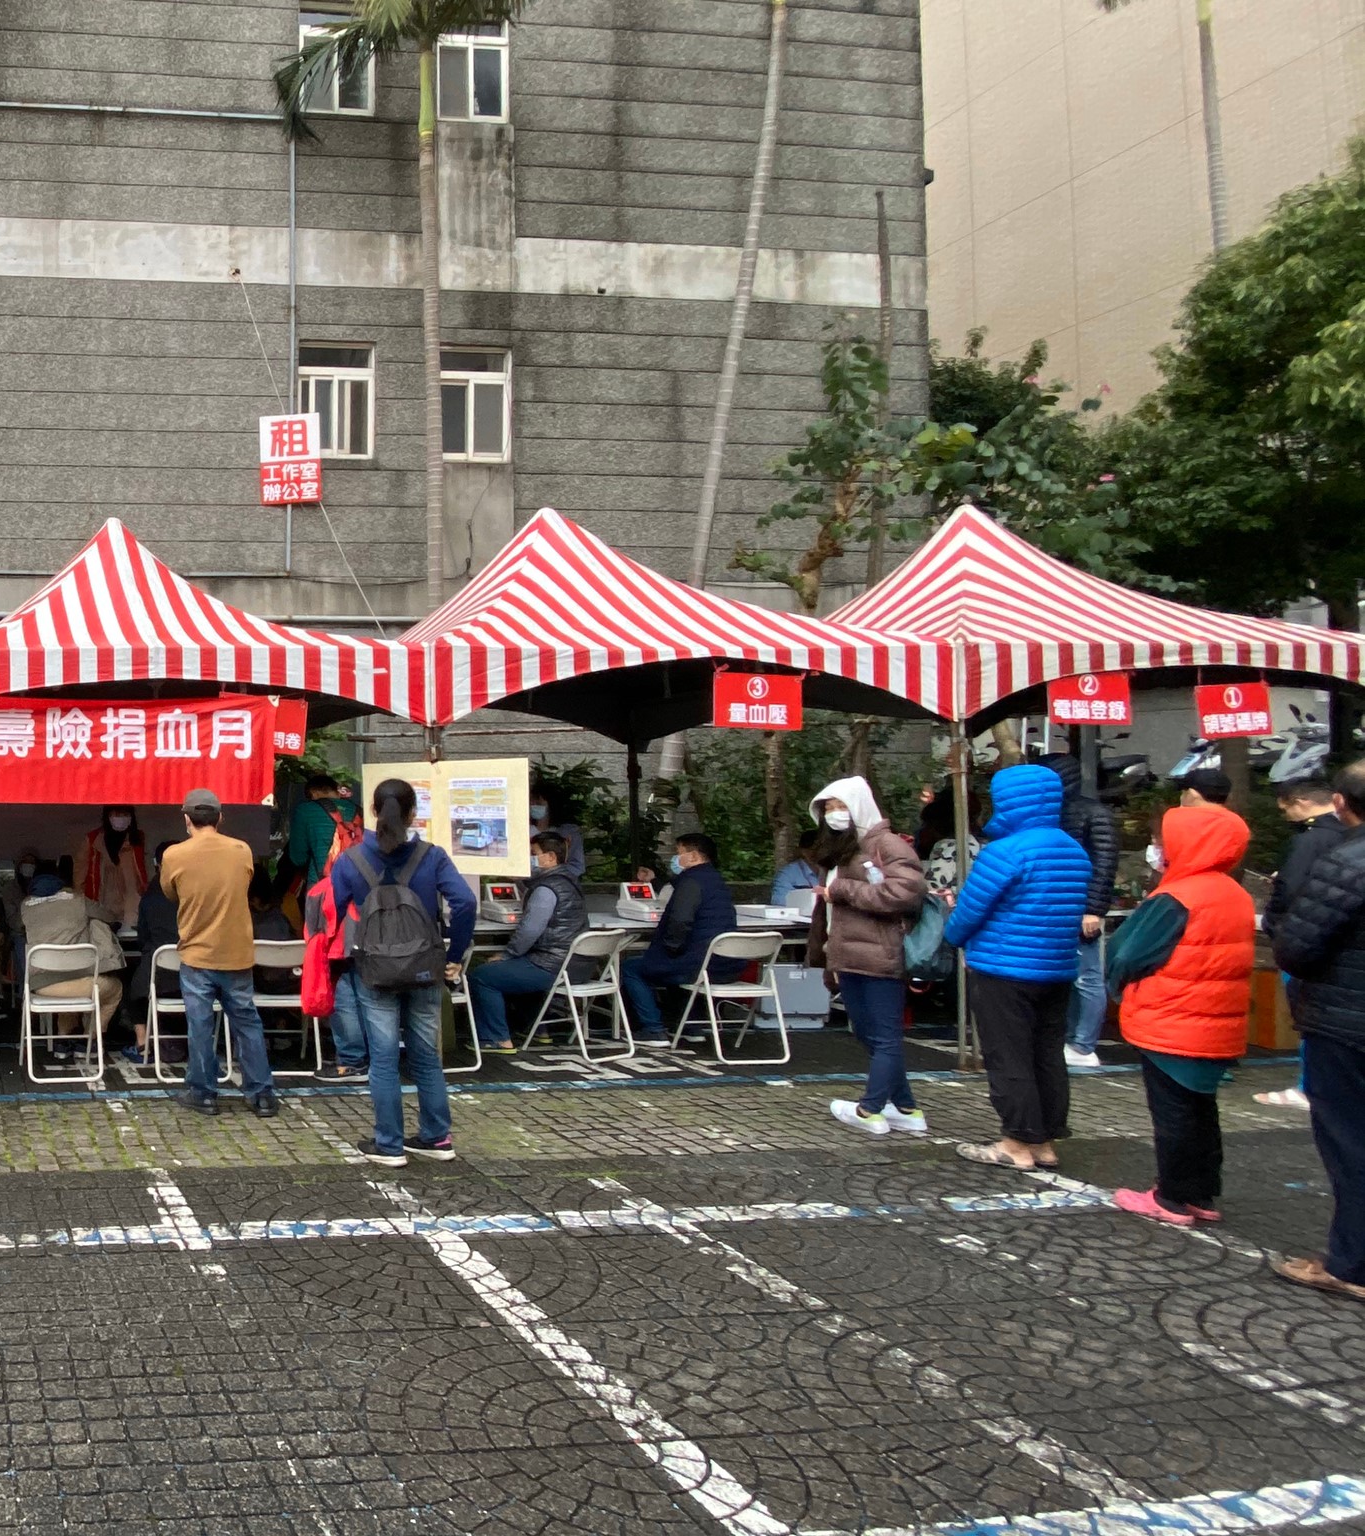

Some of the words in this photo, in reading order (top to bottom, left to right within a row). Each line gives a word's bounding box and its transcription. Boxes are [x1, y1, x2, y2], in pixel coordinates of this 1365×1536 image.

[270, 419, 310, 457] 租
[263, 461, 319, 483] 工作室
[262, 481, 319, 502] 辦公室
[728, 702, 788, 725] 量血壓
[1053, 699, 1126, 721] 電腦登錄
